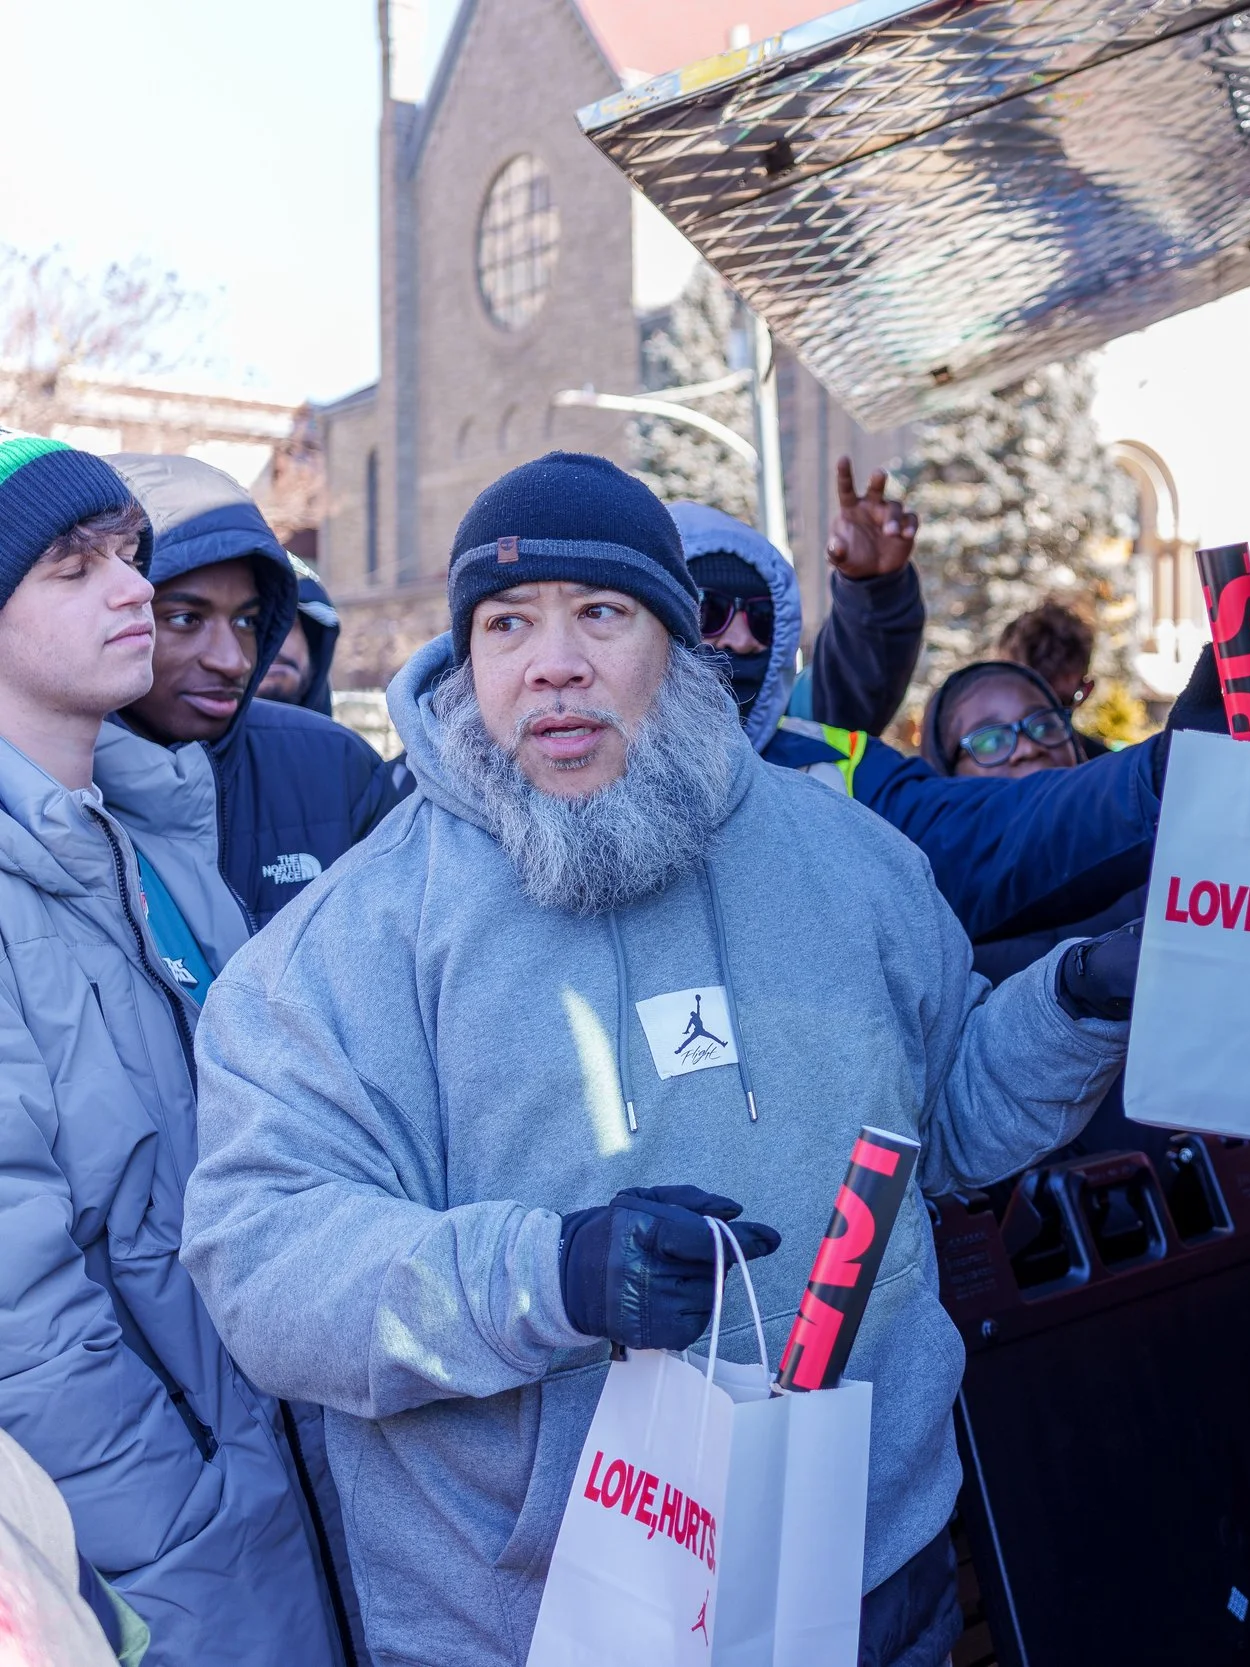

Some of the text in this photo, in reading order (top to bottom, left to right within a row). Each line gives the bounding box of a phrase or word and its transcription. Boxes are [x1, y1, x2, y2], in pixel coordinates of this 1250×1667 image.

[277, 854, 299, 865] THE
[262, 863, 301, 878] NORTH
[274, 871, 301, 885] FACE
[681, 1043, 720, 1065] Flight
